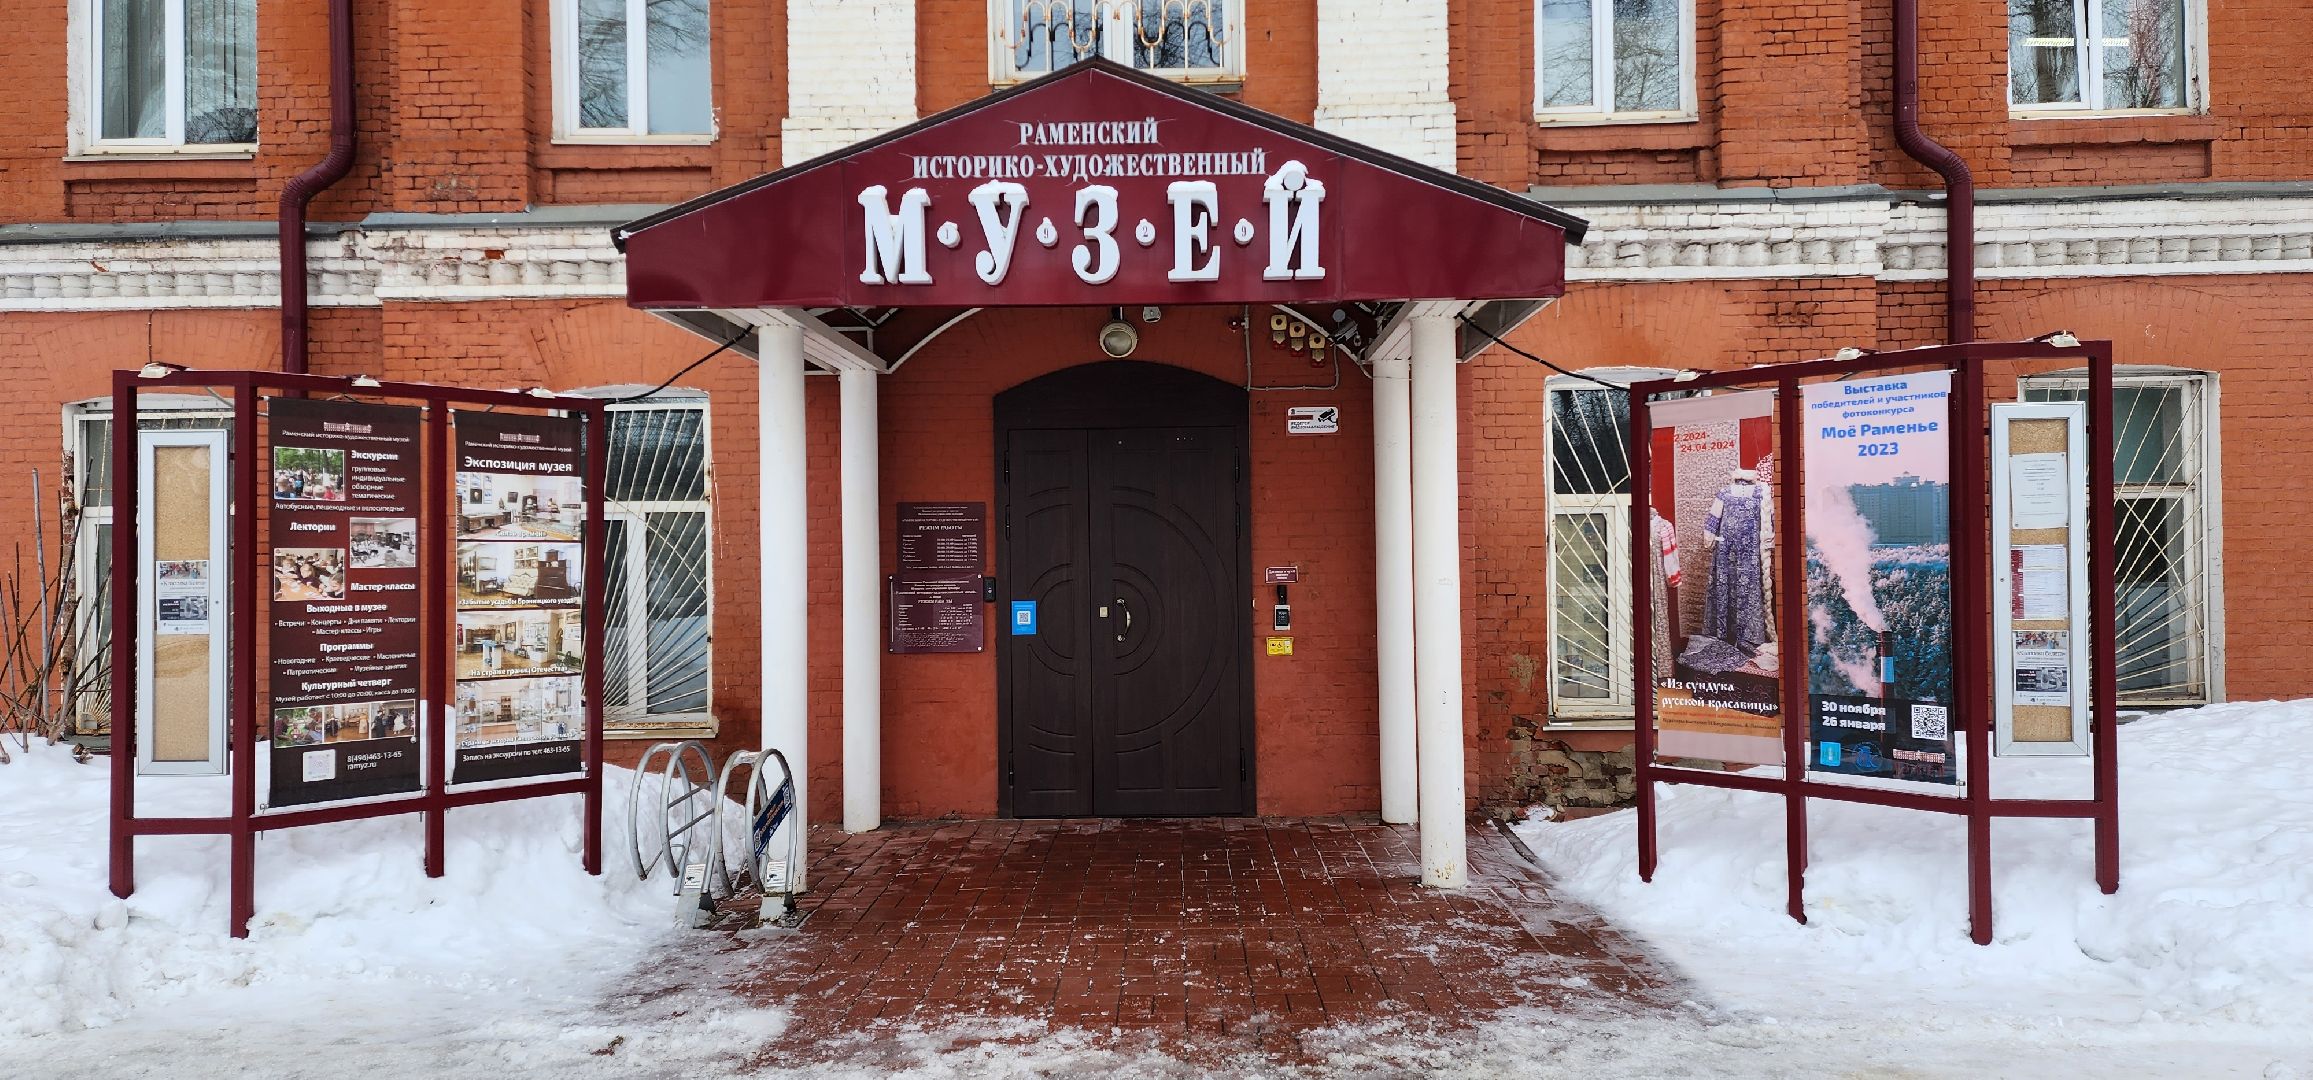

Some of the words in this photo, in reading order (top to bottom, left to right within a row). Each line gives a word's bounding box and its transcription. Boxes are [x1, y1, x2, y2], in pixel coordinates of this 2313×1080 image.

[1019, 117, 1159, 145] РАМЕНСКИЙ
[913, 148, 1266, 181] ИСТОРИКО-ХУДОЖЕСТВЕННЫЙ
[857, 160, 1326, 285] МУЗЕЙ
[1844, 381, 1908, 395] Выставка
[1811, 397, 1875, 409] победителей
[1885, 391, 1947, 404] участников
[1842, 406, 1915, 419] фотоконкурса
[1821, 424, 1856, 439] Моё
[1860, 421, 1939, 437] Раменье
[1680, 440, 1735, 453] 24.04.2024
[1858, 442, 1899, 457] 2023
[351, 450, 399, 461] Экскурсии
[352, 466, 386, 474] групповые
[464, 456, 536, 472] Экспозиция
[538, 461, 573, 473] музея
[352, 475, 406, 483] индивидуальные
[352, 484, 384, 492] обзорные
[352, 492, 396, 500] тематические
[275, 502, 315, 512] Автобусные,
[315, 504, 356, 512] пешеходные
[290, 522, 336, 533] Лектории
[351, 583, 416, 592] Мастер-классы
[306, 604, 353, 613] Выходные
[361, 604, 387, 613] музее
[279, 620, 305, 628] Встречи
[320, 643, 374, 653] Программы
[302, 679, 356, 692] Культурный
[357, 678, 392, 688] четверг
[1660, 678, 1683, 690] «Из
[1686, 682, 1735, 694] сундука
[275, 695, 297, 704] Музей
[297, 693, 325, 702] работает
[1662, 697, 1705, 709] русской
[1708, 699, 1779, 713] красавицы»
[1821, 701, 1837, 712] 30
[1839, 704, 1887, 716] ноября
[1822, 716, 1838, 727] 26
[1839, 719, 1886, 731] января
